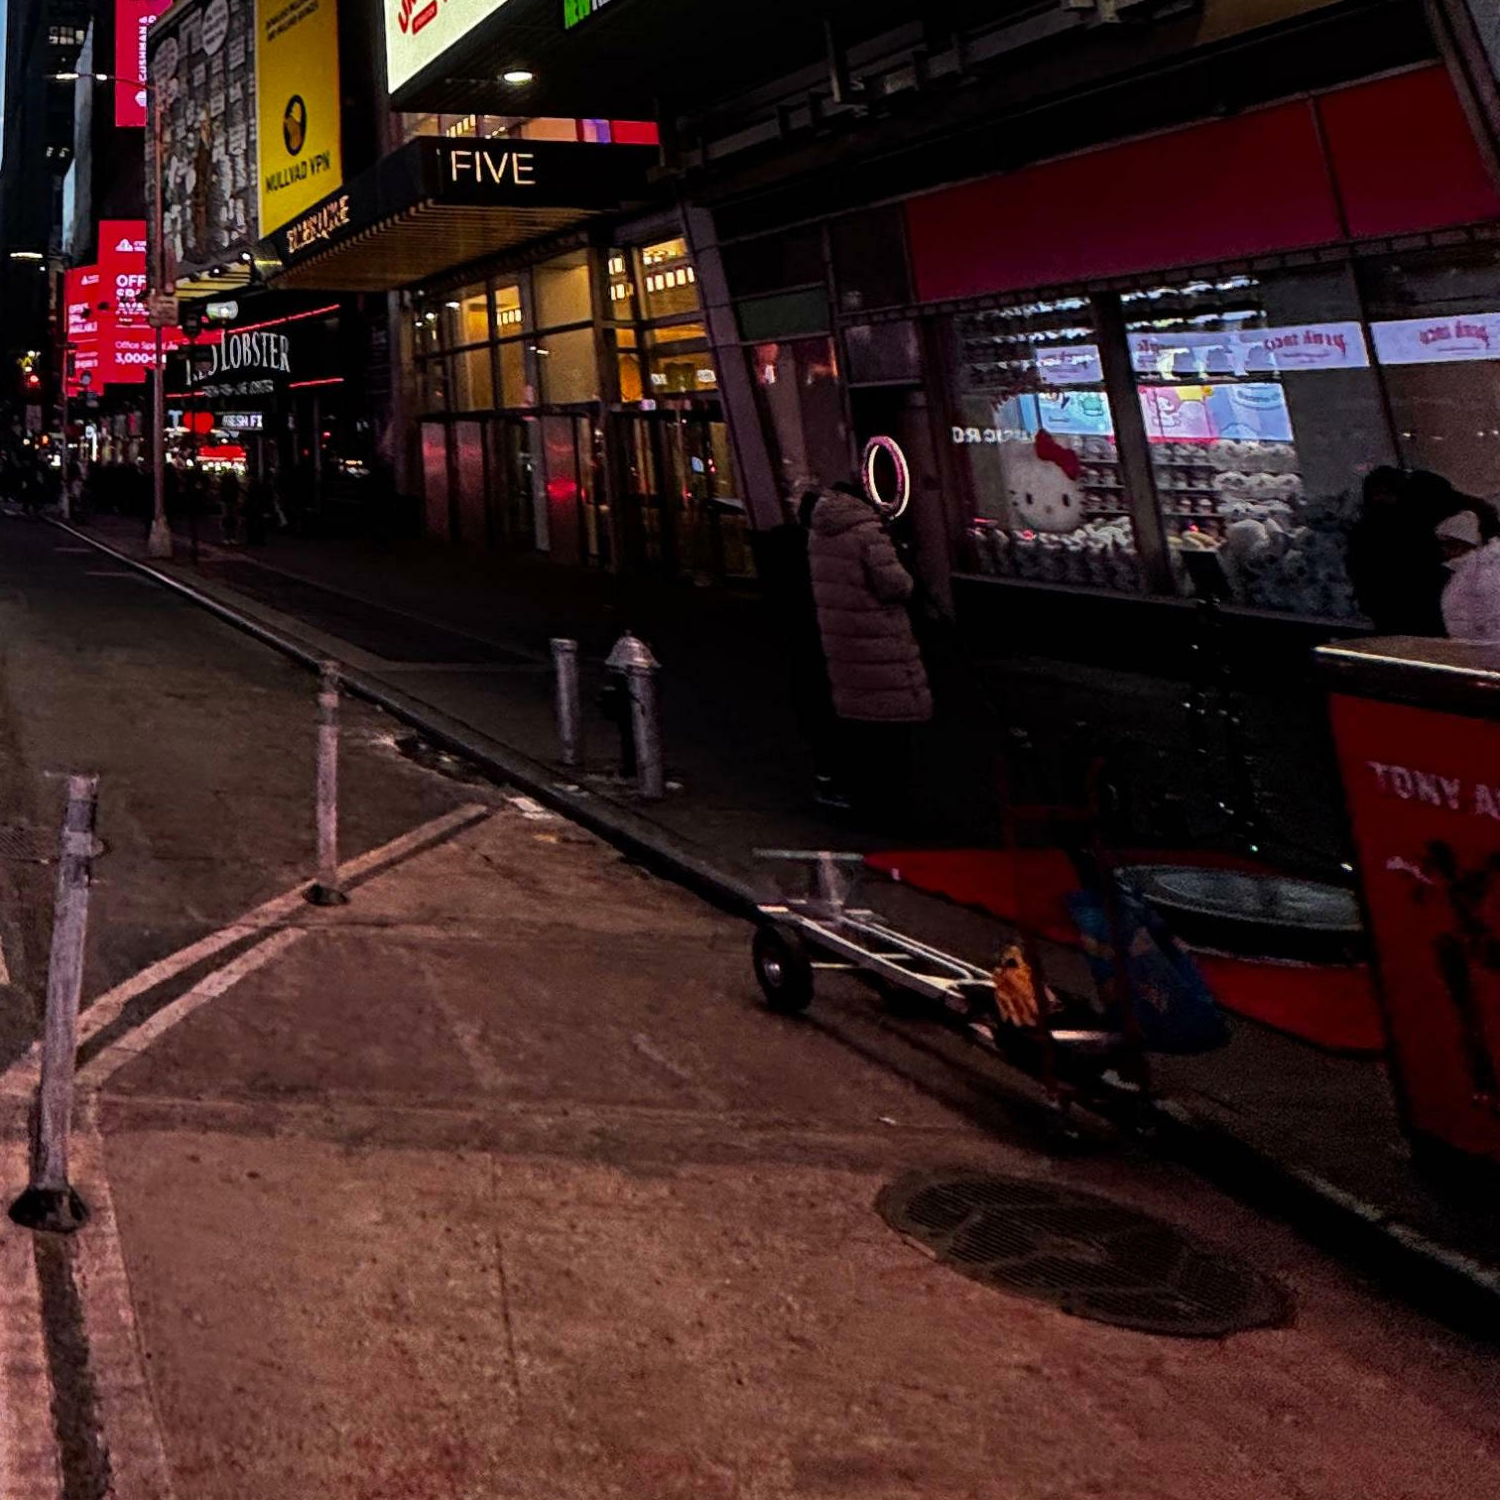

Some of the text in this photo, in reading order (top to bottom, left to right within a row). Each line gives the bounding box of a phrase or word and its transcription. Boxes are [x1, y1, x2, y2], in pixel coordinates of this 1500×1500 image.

[309, 150, 331, 176] VPN
[451, 150, 536, 186] FIVE
[221, 329, 291, 373] LOBSTER
